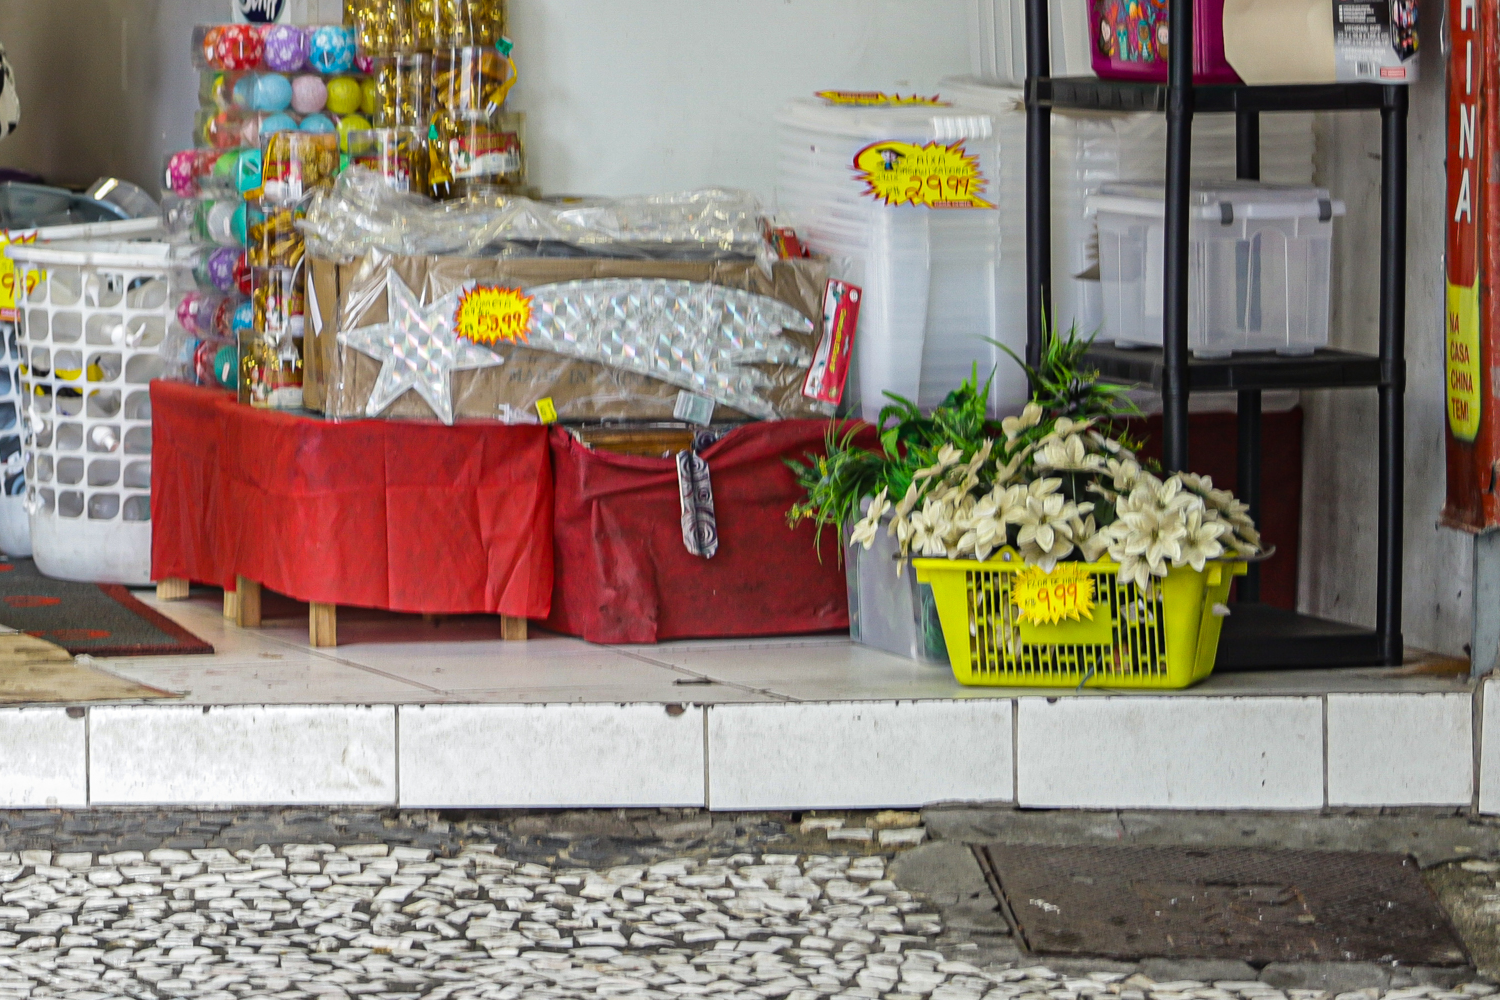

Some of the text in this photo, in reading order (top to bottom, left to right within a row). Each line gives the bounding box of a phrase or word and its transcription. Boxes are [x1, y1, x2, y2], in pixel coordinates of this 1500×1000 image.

[1449, 311, 1460, 335] NA
[1450, 341, 1471, 366] CASA
[1451, 368, 1474, 395] CHINA
